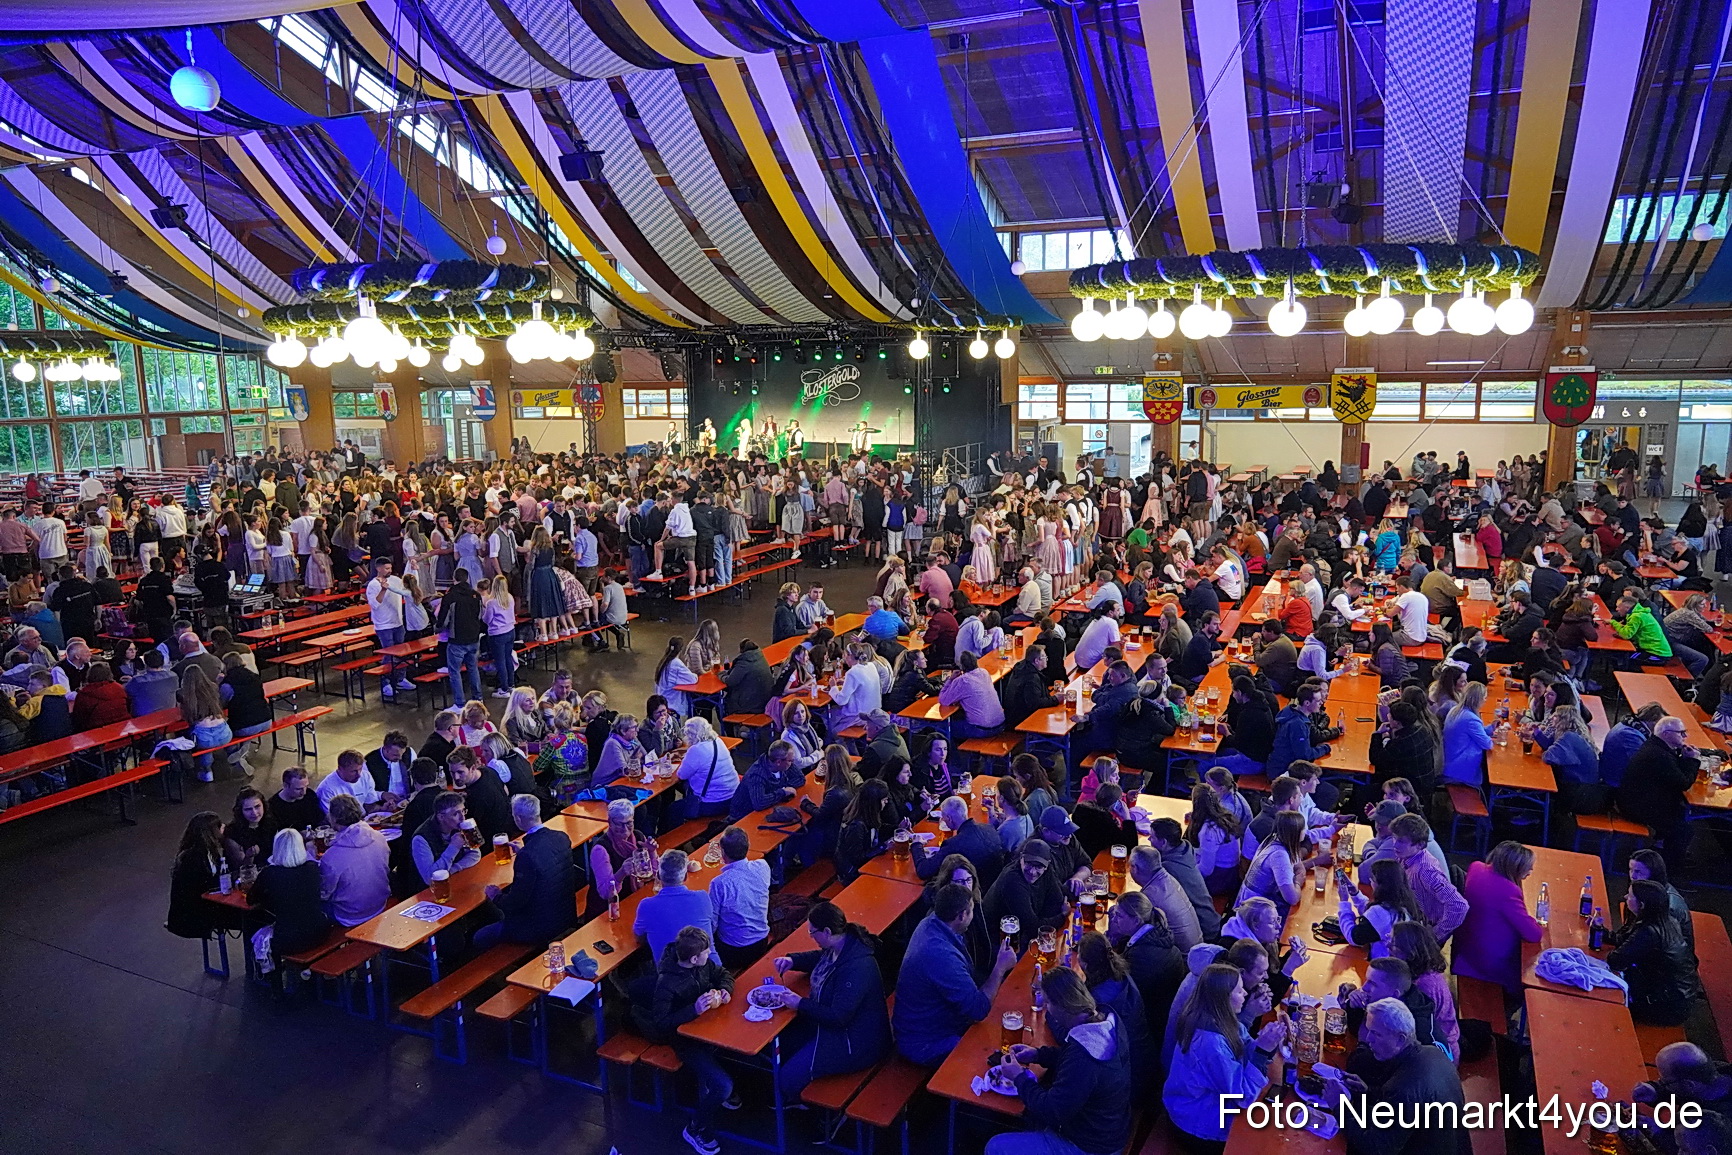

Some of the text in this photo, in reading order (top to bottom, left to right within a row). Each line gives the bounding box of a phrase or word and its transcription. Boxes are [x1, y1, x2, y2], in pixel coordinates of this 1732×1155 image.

[803, 367, 858, 398] KLOSTERGOLD
[1237, 386, 1282, 408] Glossner
[1261, 399, 1283, 408] Bier
